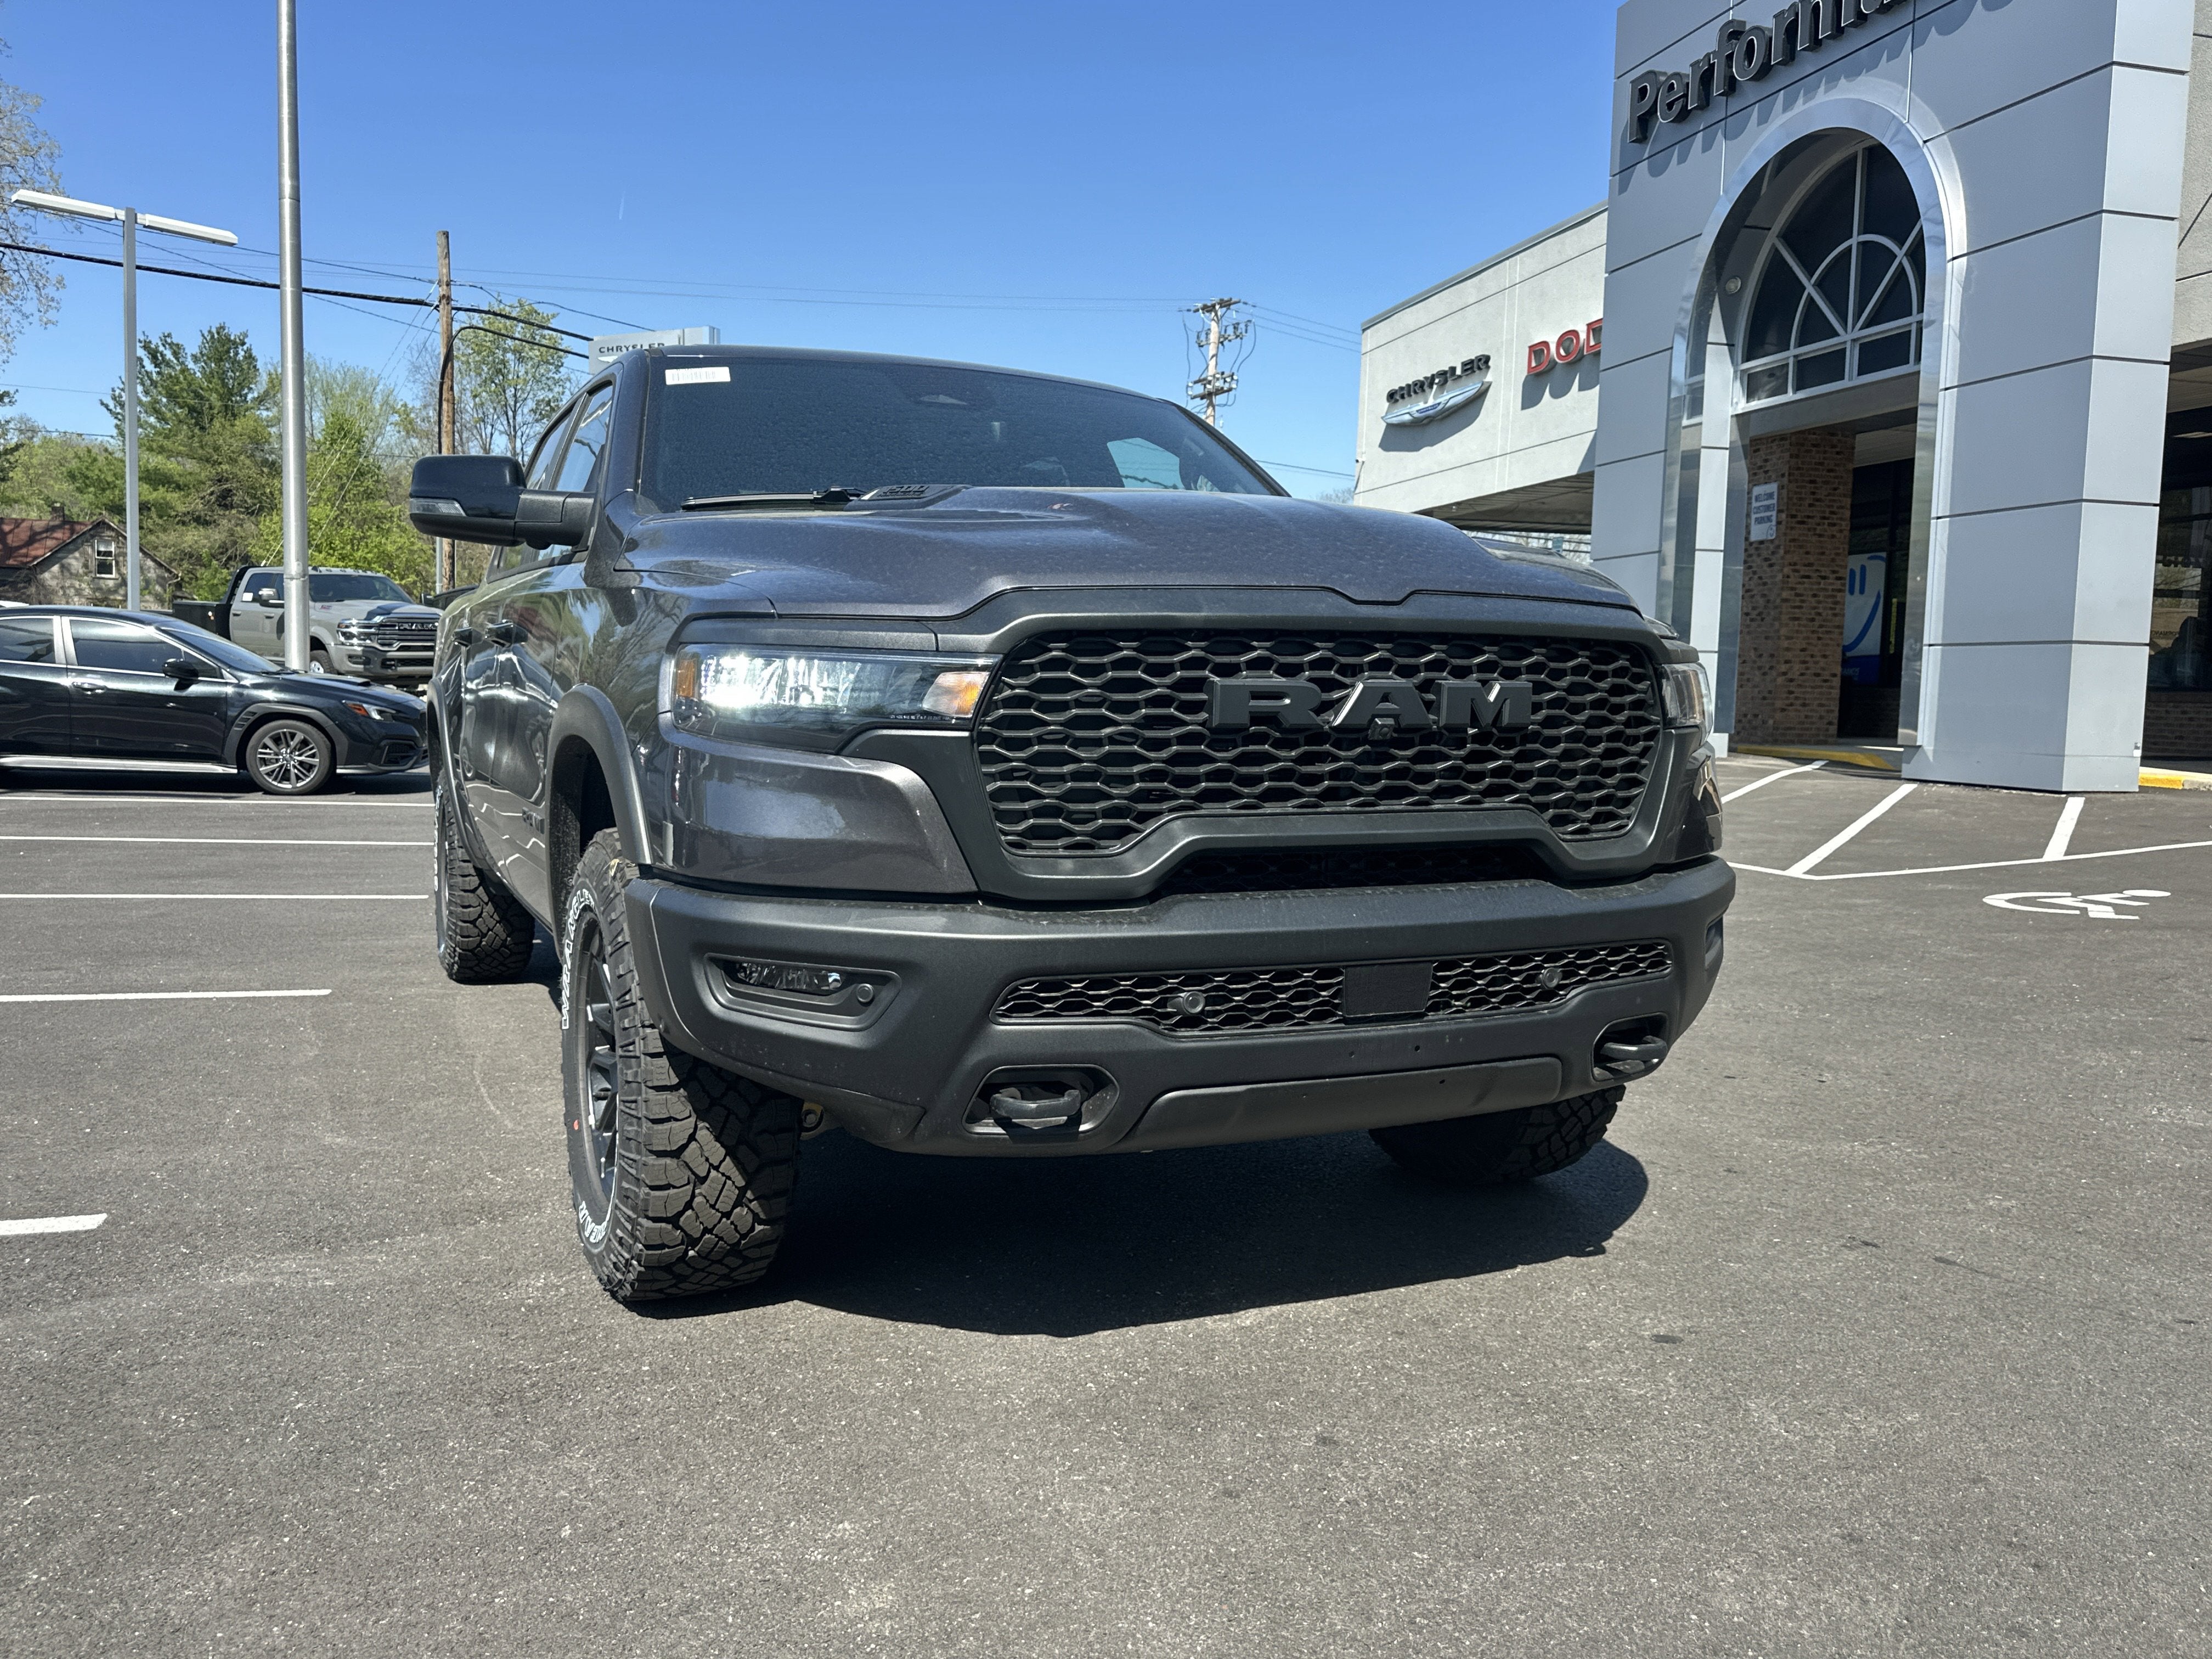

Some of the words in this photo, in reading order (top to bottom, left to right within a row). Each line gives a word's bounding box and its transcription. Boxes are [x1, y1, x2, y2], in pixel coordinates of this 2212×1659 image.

[1386, 354, 1491, 404] CHRYSLER
[1204, 678, 1532, 729] RAM
[562, 888, 596, 1029] WRANGLER
